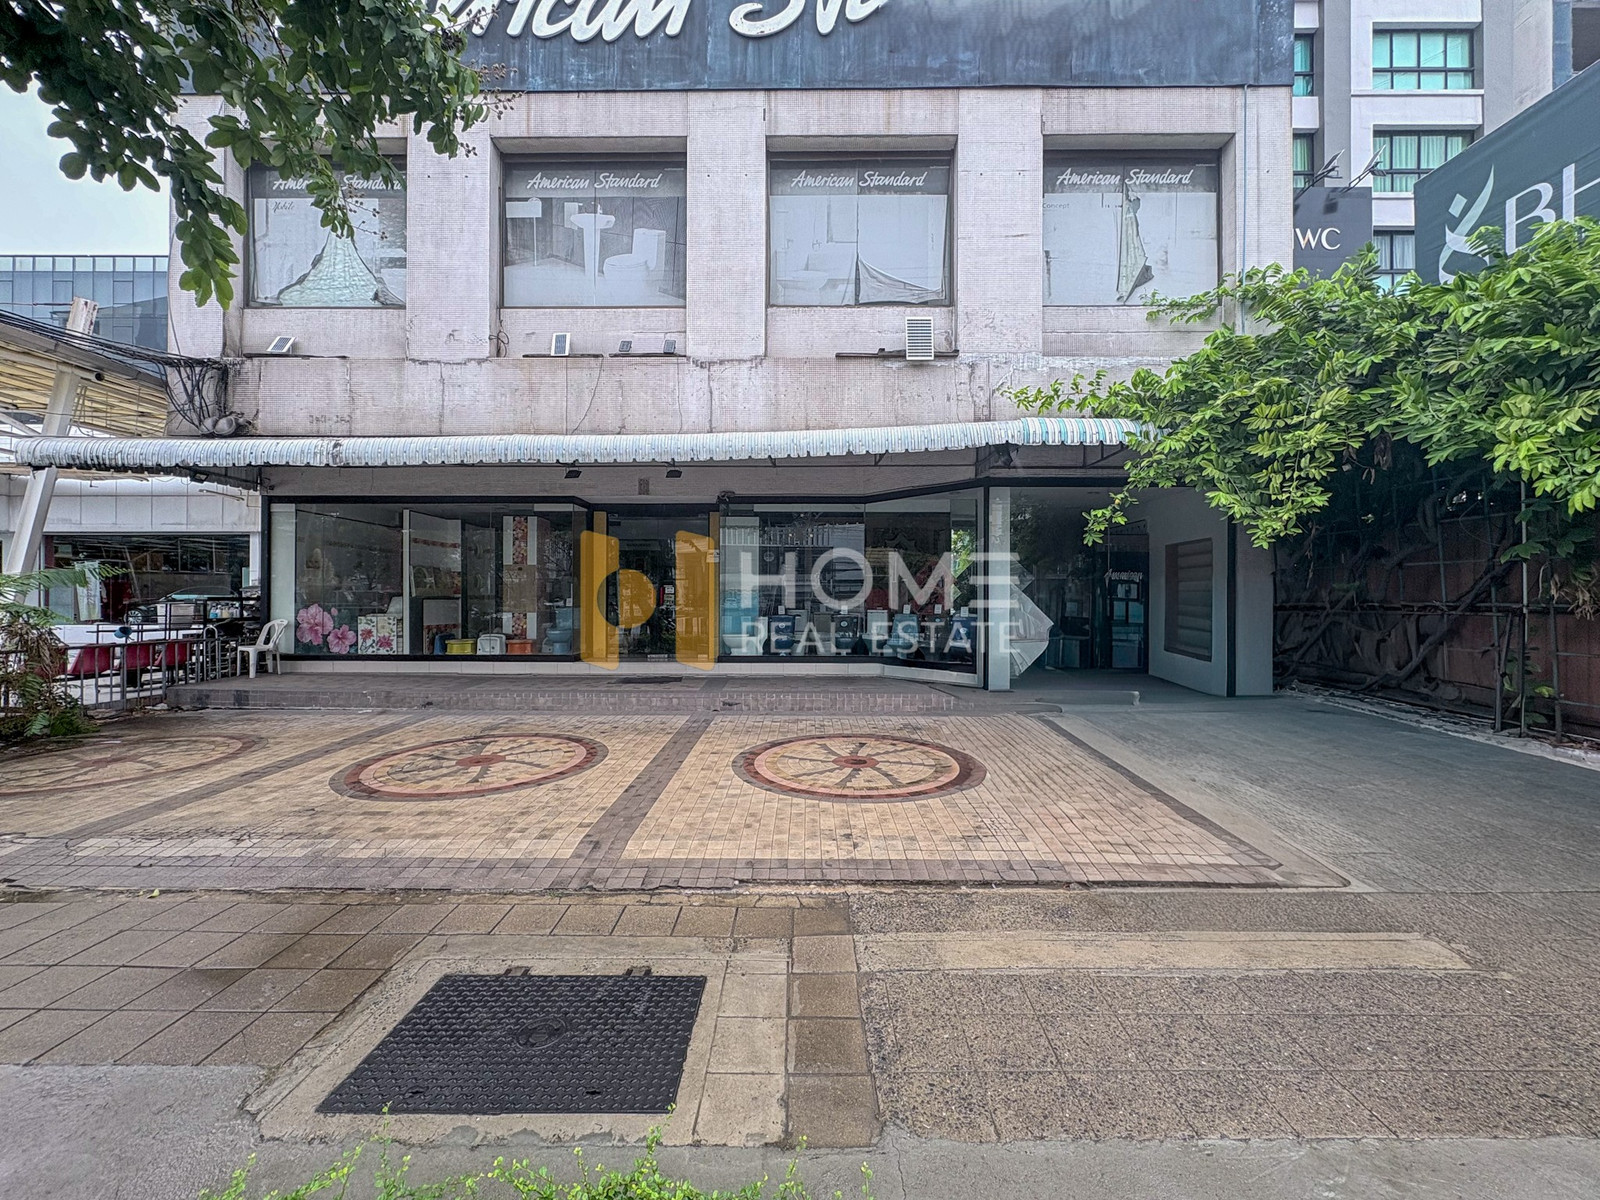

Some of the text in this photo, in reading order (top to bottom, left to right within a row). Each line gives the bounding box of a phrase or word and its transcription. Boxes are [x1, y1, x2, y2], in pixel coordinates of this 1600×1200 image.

[342, 174, 405, 190] Standad
[527, 172, 663, 189] American Standard
[790, 170, 928, 188] American Standard
[1056, 168, 1194, 185] American Standard
[1292, 228, 1341, 250] WC
